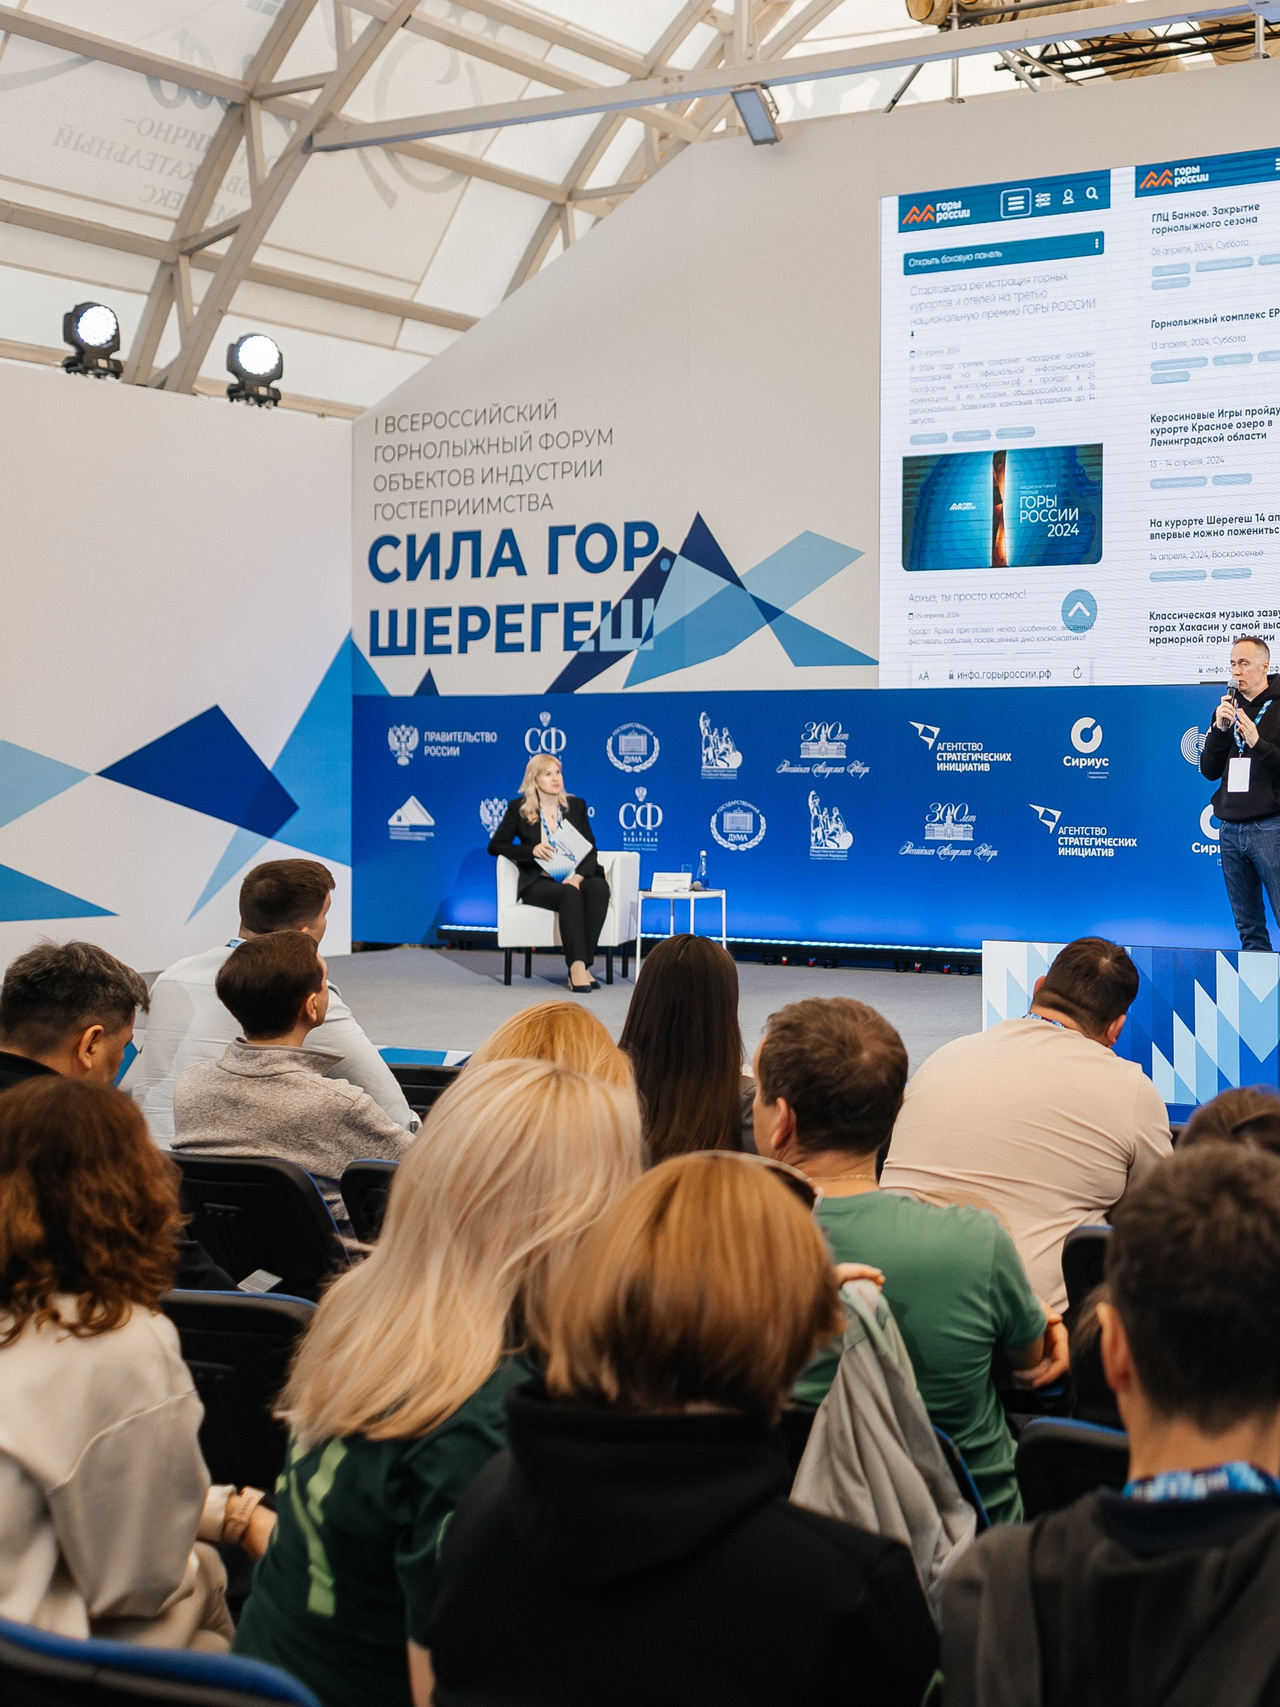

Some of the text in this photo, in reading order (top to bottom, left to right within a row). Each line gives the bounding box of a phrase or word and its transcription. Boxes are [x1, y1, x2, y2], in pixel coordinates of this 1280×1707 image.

[1175, 165, 1200, 175] горы
[1175, 173, 1209, 187] россии
[936, 201, 961, 210] горы
[1152, 202, 1260, 223] ГЛЦ Банное. Закрытие
[936, 209, 970, 223] россии
[1152, 216, 1258, 236] горнолыжного сезона
[909, 250, 1003, 267] Открыть боковую панель
[910, 272, 1068, 296] Стартовала регистрация горных
[910, 299, 1096, 326] национальную премию ГОРЫ РОССИИ
[1151, 314, 1217, 329] Горнолыжный
[1221, 310, 1266, 322] комплекс
[385, 398, 557, 433] ВСЕРОССИЙСКИЙ
[1150, 411, 1215, 424] Керосиновые
[1218, 408, 1242, 419] Игры
[1150, 425, 1188, 436] курорте
[1191, 421, 1233, 432] Красное
[1236, 420, 1265, 430] озеро
[375, 428, 613, 463] ГОРНОЛЫЖНЫЙ ФОРУМ
[1150, 431, 1266, 447] Ленинградской области
[373, 459, 602, 492] ОБЪЕКТОВ ИНДУСТРИИ
[374, 494, 553, 521] ГОСТЕПРИИМСТВА
[1020, 495, 1057, 508] ГОРЫ
[1020, 508, 1079, 523] РОССИИ
[1150, 519, 1162, 528] На
[1165, 518, 1203, 528] курорте
[1207, 514, 1252, 525] Шерегеш
[1255, 514, 1265, 522] 14
[1048, 523, 1079, 537] 2024
[1150, 530, 1190, 541] впервые
[1193, 528, 1224, 538] можно
[368, 528, 527, 583] СИЛА
[909, 590, 1026, 603] Архыз, ты просто космос!
[1149, 610, 1216, 621] Классическая
[1219, 610, 1254, 620] музыка
[369, 598, 654, 657] ШЕРЕГЕШ
[1149, 623, 1176, 633] горах
[1179, 622, 1219, 632] Хакасии
[1223, 623, 1227, 632] у
[1230, 620, 1260, 630] самой
[1149, 634, 1230, 646] мраморной горы
[957, 669, 1051, 680] инфо.горыроссии.рф
[424, 732, 498, 743] ПРАВИТЕЛЬСТВО
[524, 727, 567, 754] СФ
[424, 746, 460, 757] РОССИИ
[937, 743, 983, 751] АГЕНТСТВО
[623, 756, 642, 764] ДУМА
[937, 753, 1011, 761] СТРАТЕГИЧЕСКИХ
[1063, 756, 1109, 768] Сириус
[937, 763, 990, 772] ИНИЦИАТИВ
[717, 800, 760, 814] ГОСУДАРСТВЕННАЯ
[619, 803, 663, 830] СФ
[728, 834, 748, 842] ДУМА
[1058, 827, 1107, 836] АГЕНТСТВО
[1058, 837, 1137, 847] СТРАТЕГИЧЕСКИХ
[1059, 847, 1114, 857] ИНИЦИАТИВ
